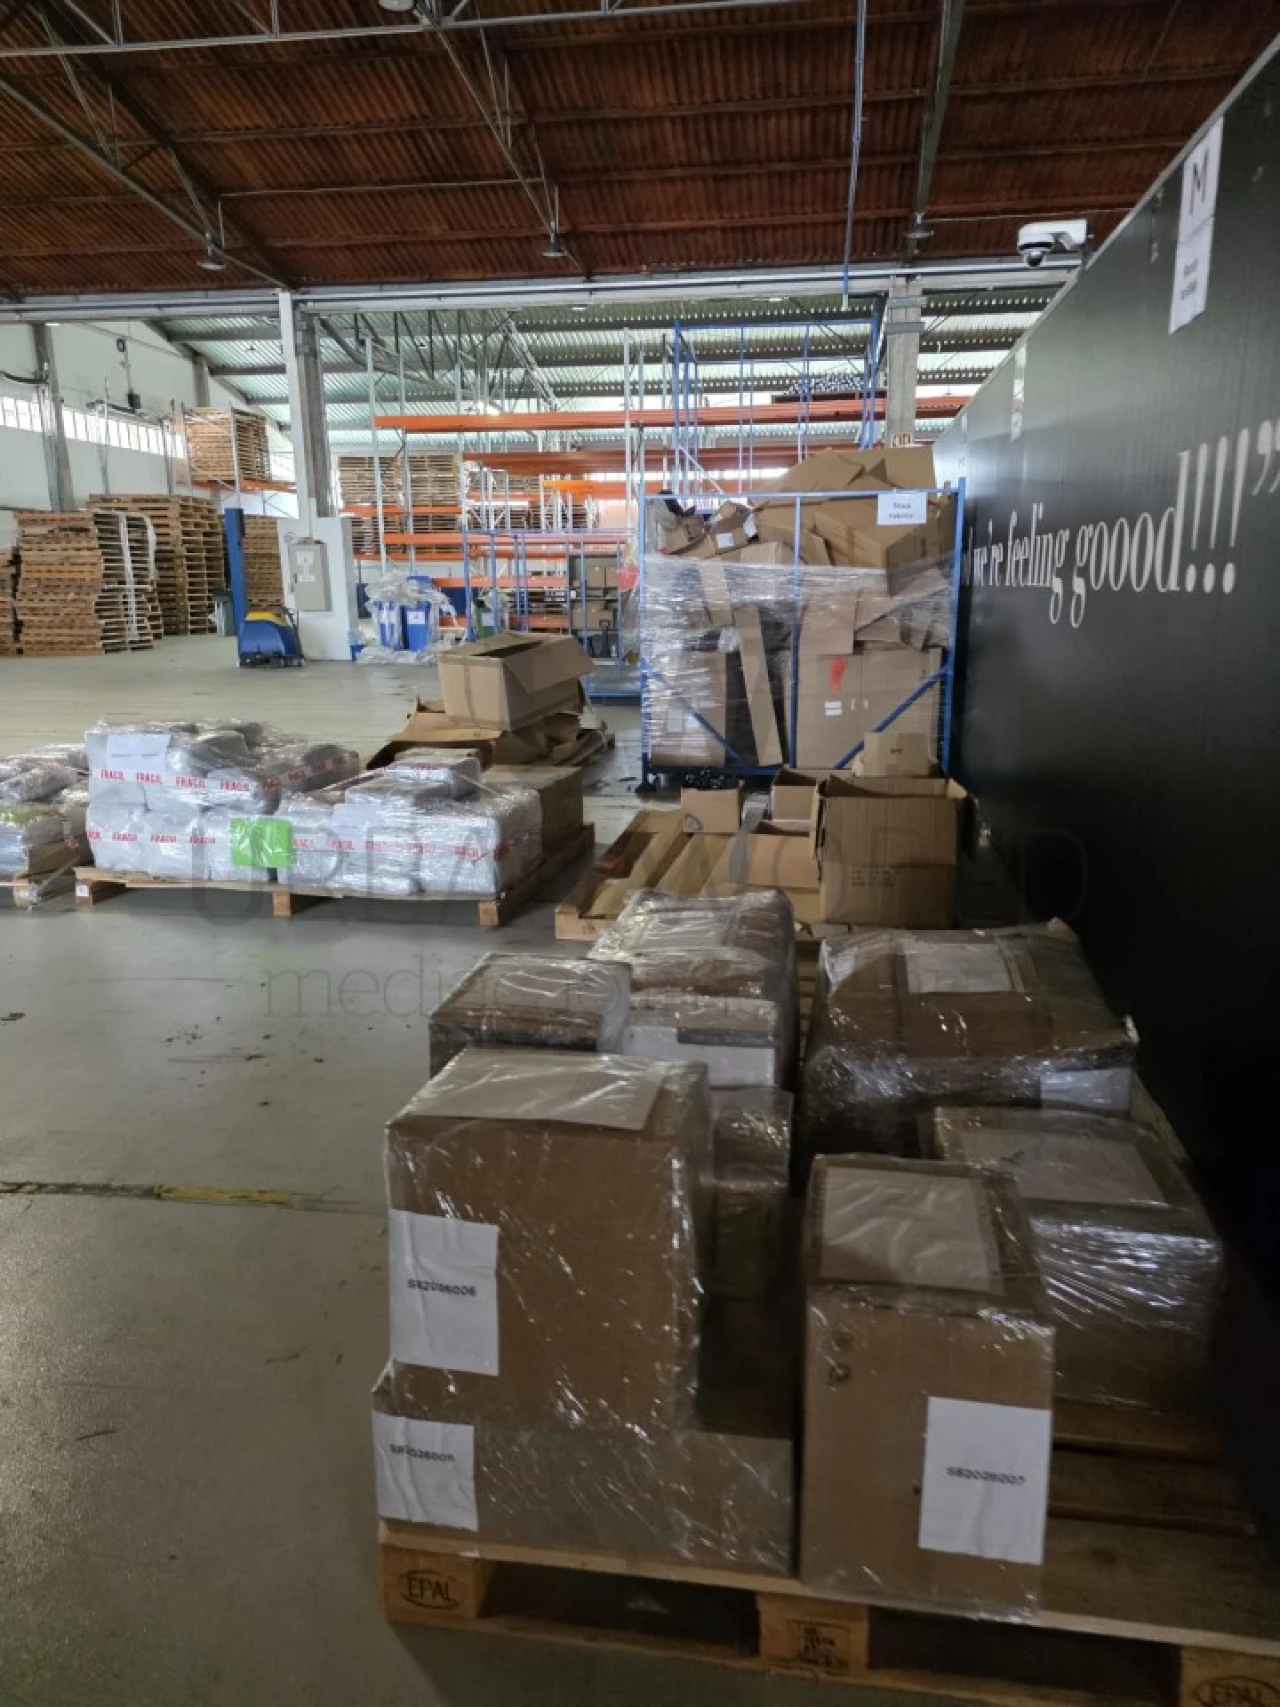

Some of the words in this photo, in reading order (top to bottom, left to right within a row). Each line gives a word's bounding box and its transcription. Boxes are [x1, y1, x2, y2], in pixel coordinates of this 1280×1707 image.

[1189, 148, 1210, 216] M
[973, 517, 1004, 586] we're
[1006, 502, 1070, 624] feeling
[100, 769, 124, 781] FRAGIL
[136, 772, 164, 785] FRAGIL
[175, 776, 206, 789] FRAGIL
[220, 780, 250, 792] FRAGIL
[407, 1575, 452, 1602] EPAL
